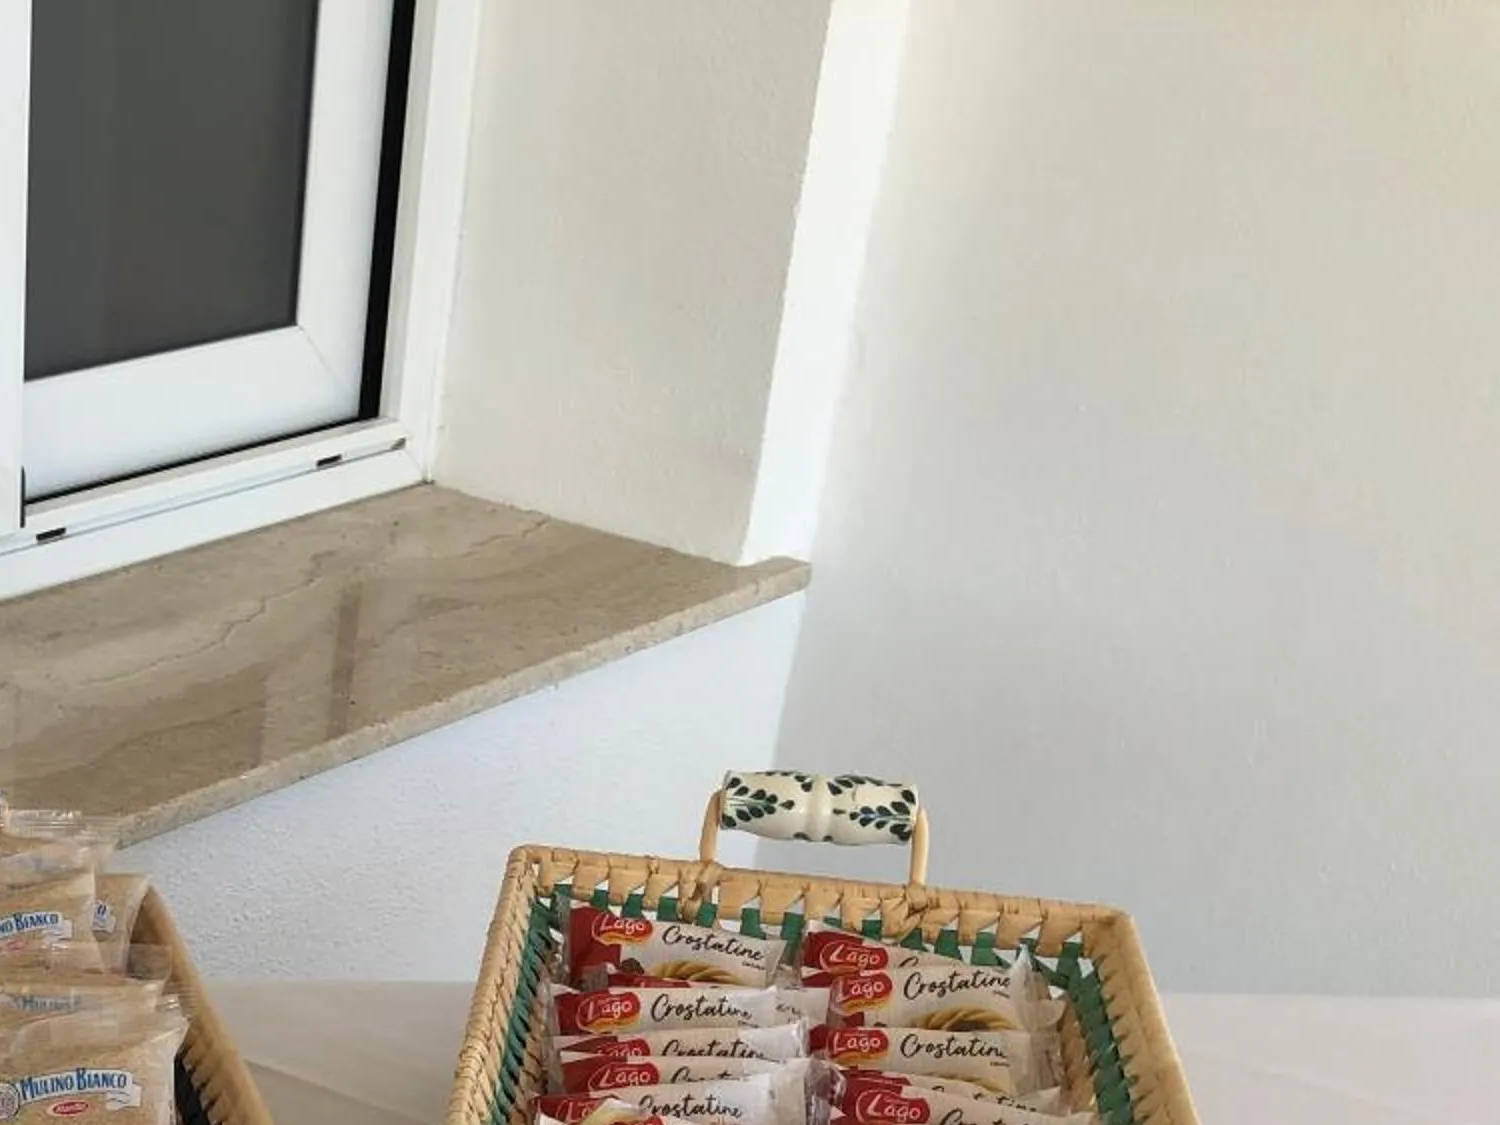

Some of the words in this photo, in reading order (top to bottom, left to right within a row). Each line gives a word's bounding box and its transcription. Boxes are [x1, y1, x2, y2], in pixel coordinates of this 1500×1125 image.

[600, 912, 647, 937] Lago
[662, 924, 765, 961] Crostatine
[828, 944, 881, 966] Lago
[837, 976, 885, 1001] Lago
[903, 969, 1011, 1000] Crostatine
[833, 1033, 881, 1055] Lago
[21, 1073, 75, 1100] MULINO
[76, 1067, 127, 1092] BIANCO
[866, 1090, 922, 1122] Lago
